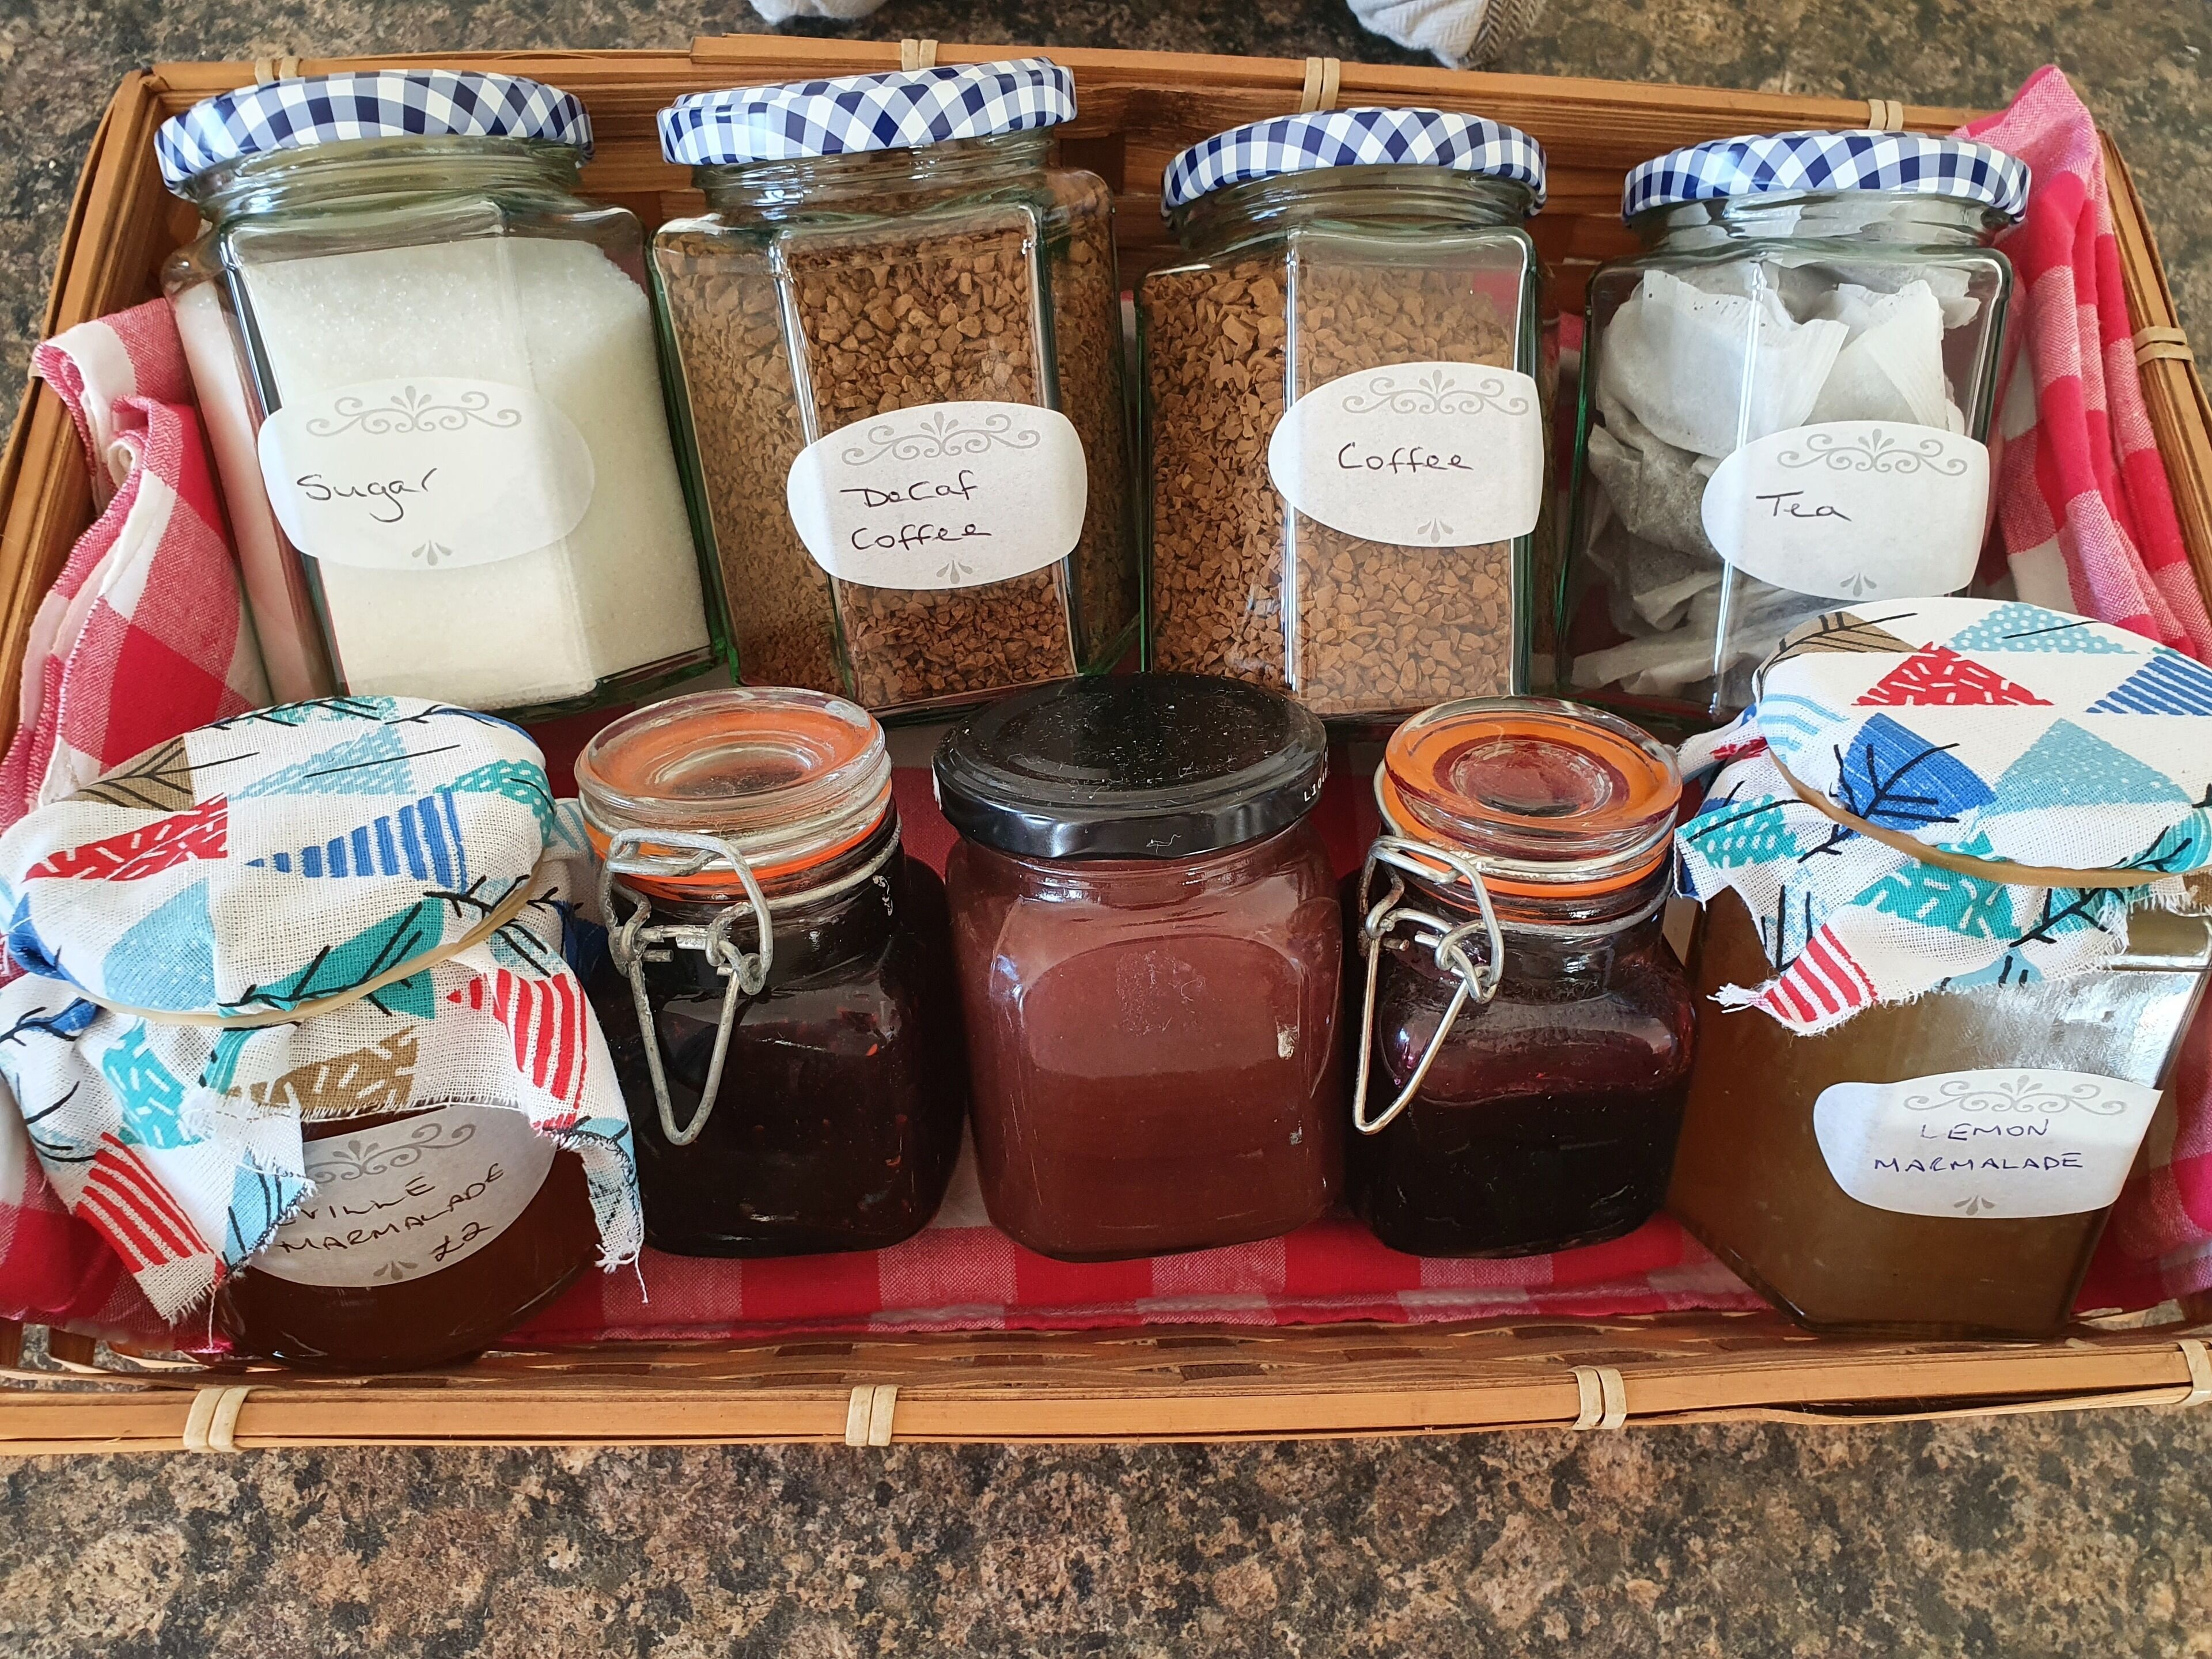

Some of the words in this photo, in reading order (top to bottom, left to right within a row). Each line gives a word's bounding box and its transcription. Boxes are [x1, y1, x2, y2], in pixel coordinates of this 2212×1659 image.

[1338, 441, 1474, 474] Coffee
[297, 467, 438, 523] Sugar
[1755, 490, 1853, 522] Tea
[851, 524, 992, 551] Coffee
[1920, 1119, 2049, 1141] LEMON
[1874, 1153, 2084, 1173] MARMALADE
[276, 1162, 505, 1253] MARMALADE
[279, 1176, 436, 1226] VILLE
[429, 1221, 494, 1262] £2
